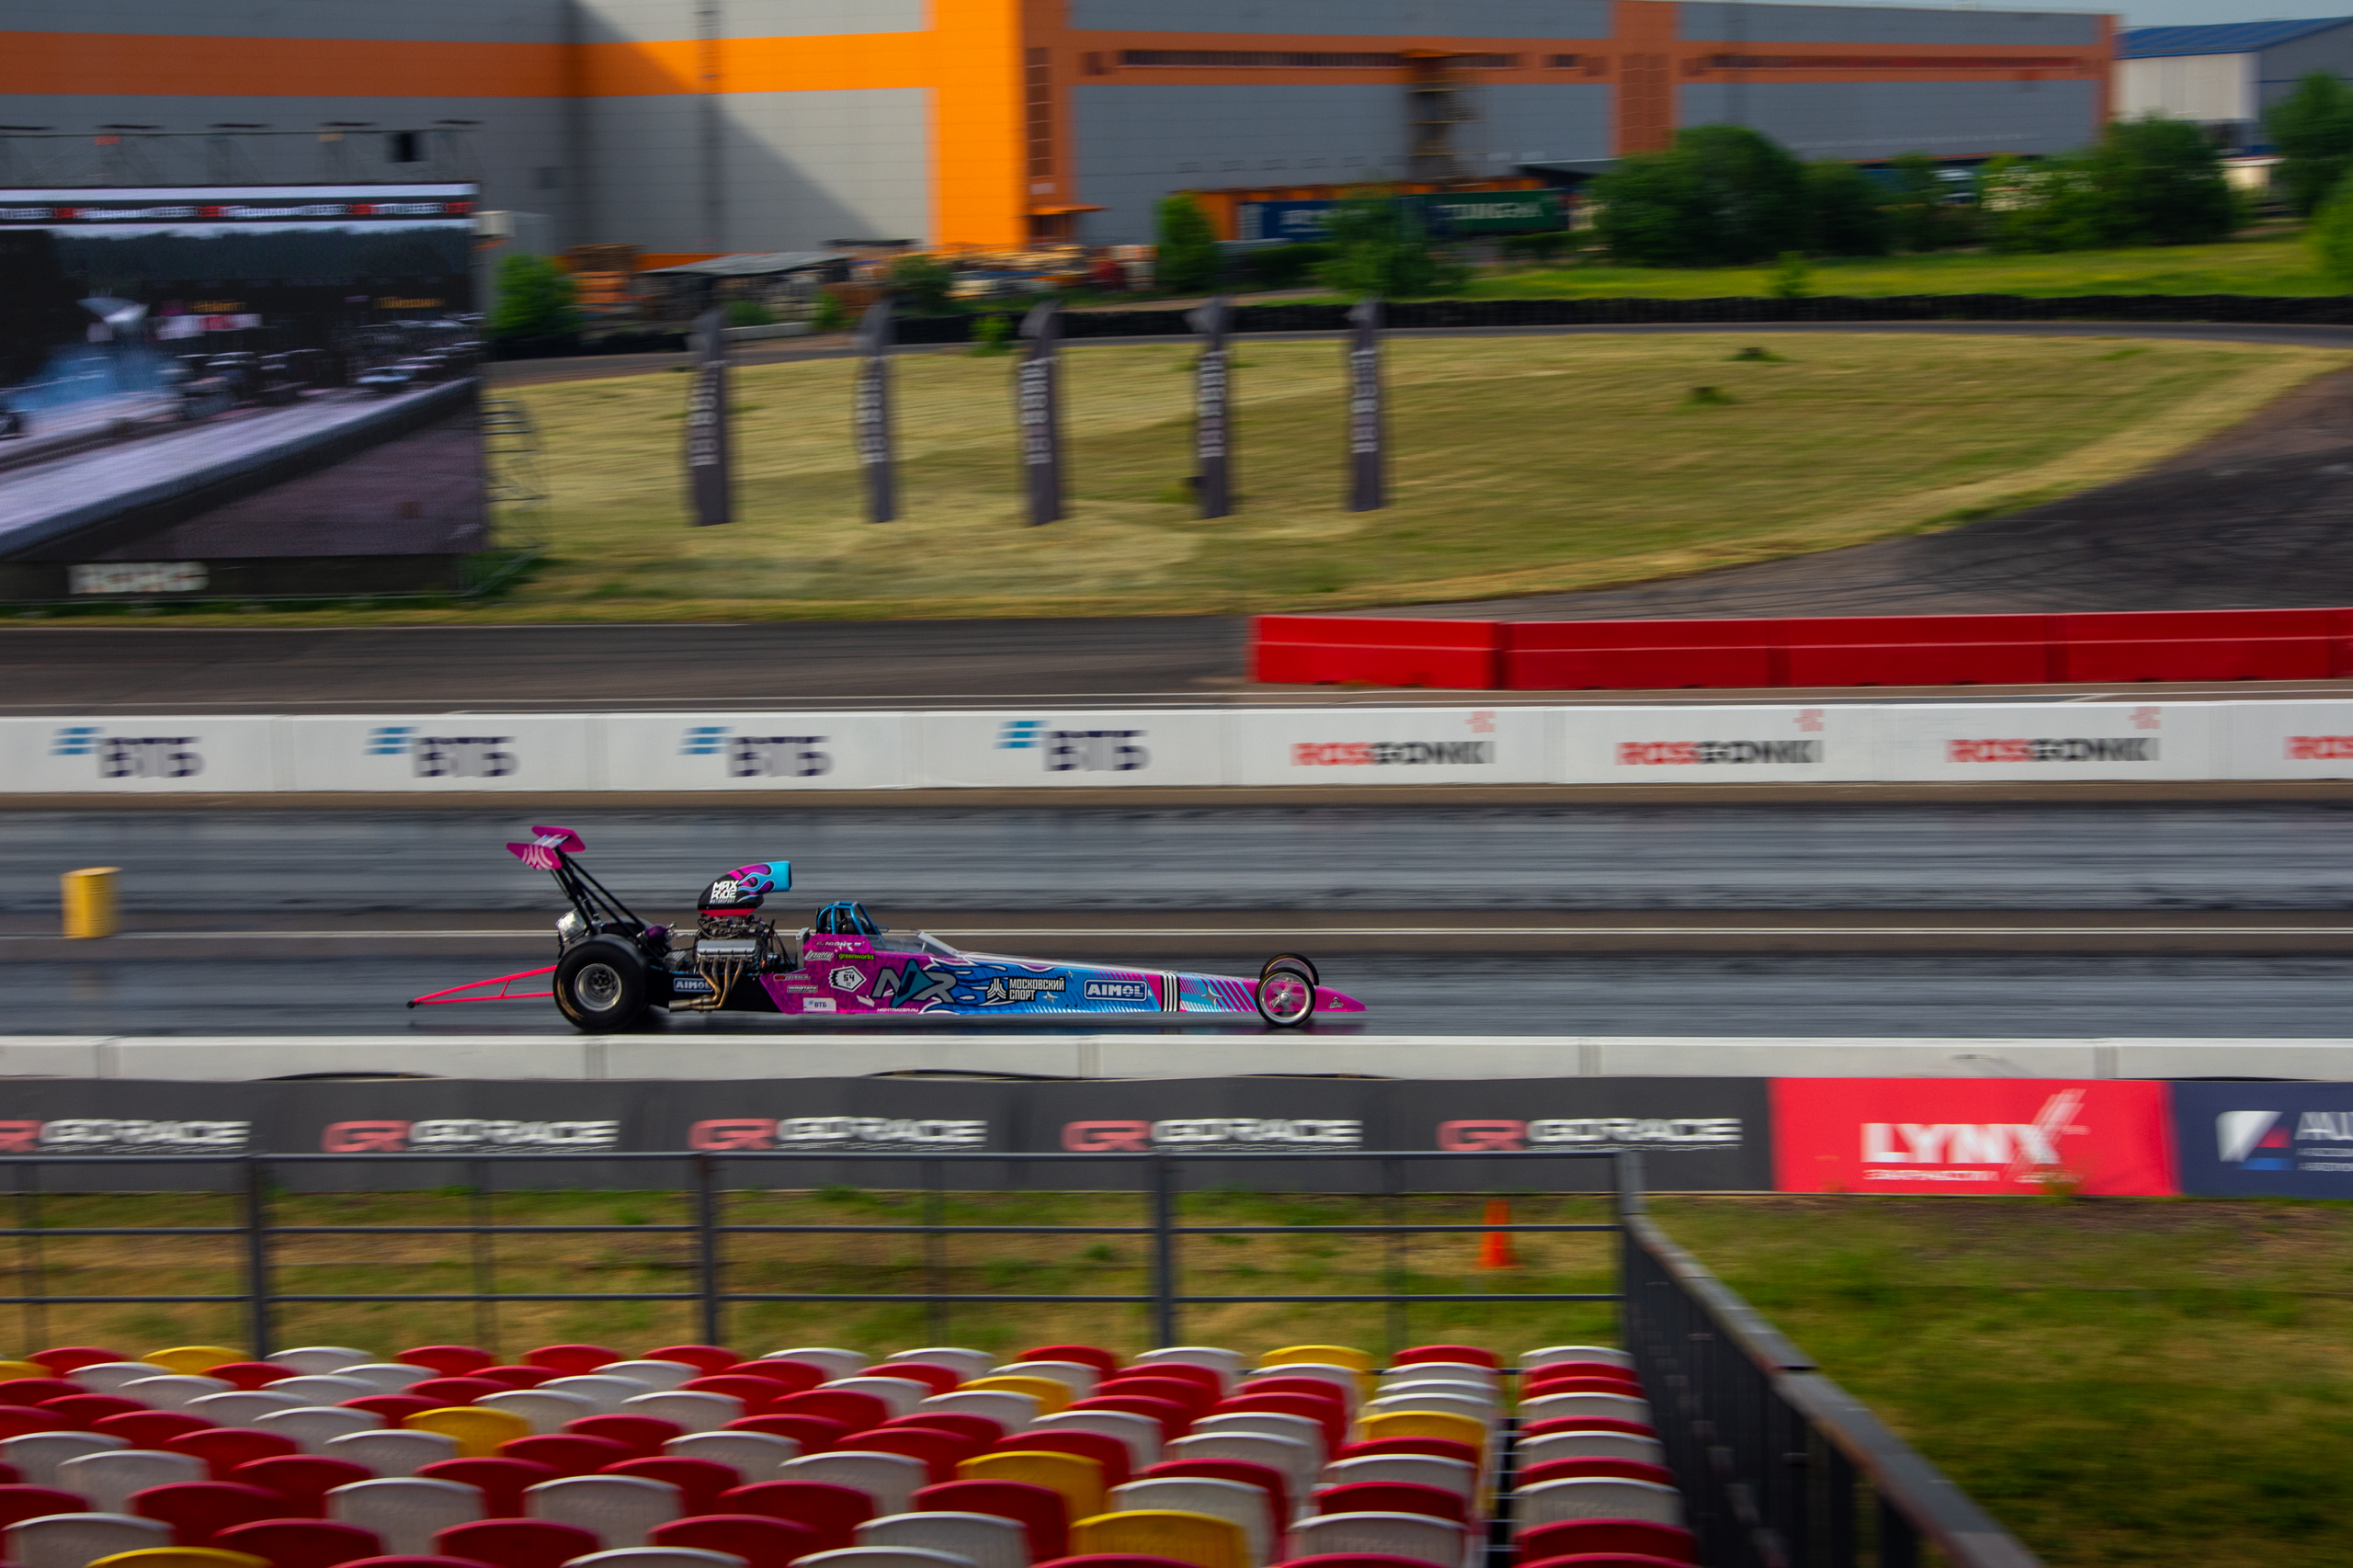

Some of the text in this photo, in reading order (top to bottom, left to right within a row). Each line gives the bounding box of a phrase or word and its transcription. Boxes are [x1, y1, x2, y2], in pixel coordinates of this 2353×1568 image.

[712, 880, 739, 892] MAX
[843, 974, 855, 983] 54
[1009, 977, 1065, 992] МОСКОВСКИЙ
[676, 981, 712, 990] AIMOL
[1087, 983, 1144, 998] AIMOL
[1009, 989, 1037, 1001] СПОРТ
[813, 1001, 827, 1009] ВТБ
[1859, 1098, 2077, 1165] LYNX
